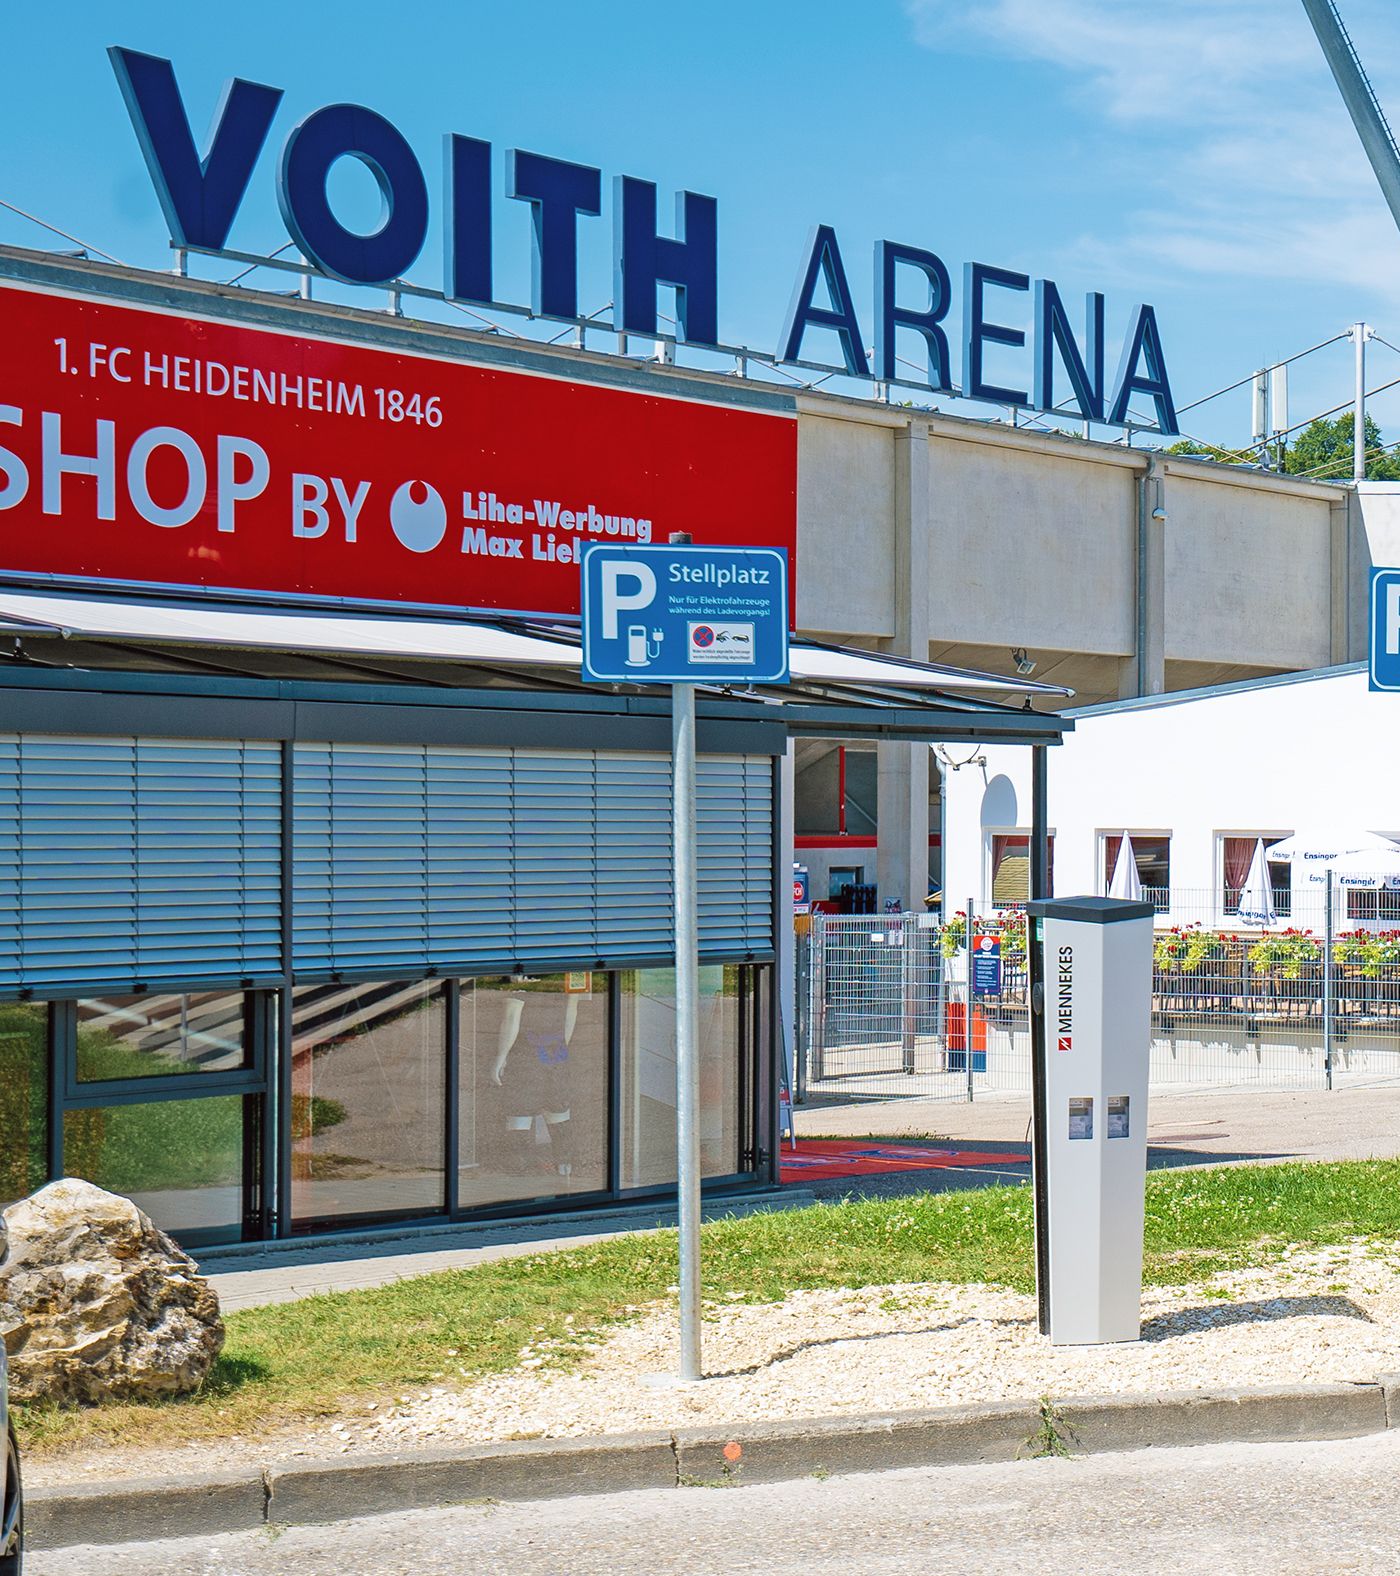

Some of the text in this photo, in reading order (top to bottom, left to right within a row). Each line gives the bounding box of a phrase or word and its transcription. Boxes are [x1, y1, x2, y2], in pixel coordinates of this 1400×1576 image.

[106, 45, 1179, 436] VOITH ARENA
[54, 337, 443, 428] 1. FC HEIDENHEIM 1846
[292, 473, 372, 543] BY
[462, 491, 652, 544] Liha-Werbung
[461, 527, 524, 560] Max
[601, 560, 657, 639] P
[668, 563, 770, 588] Stellplatz
[669, 595, 770, 608] Nur für Elektrofahrzeuge
[669, 606, 770, 617] während des Ladevorgangs!
[1058, 946, 1073, 1033] MENNEKES
